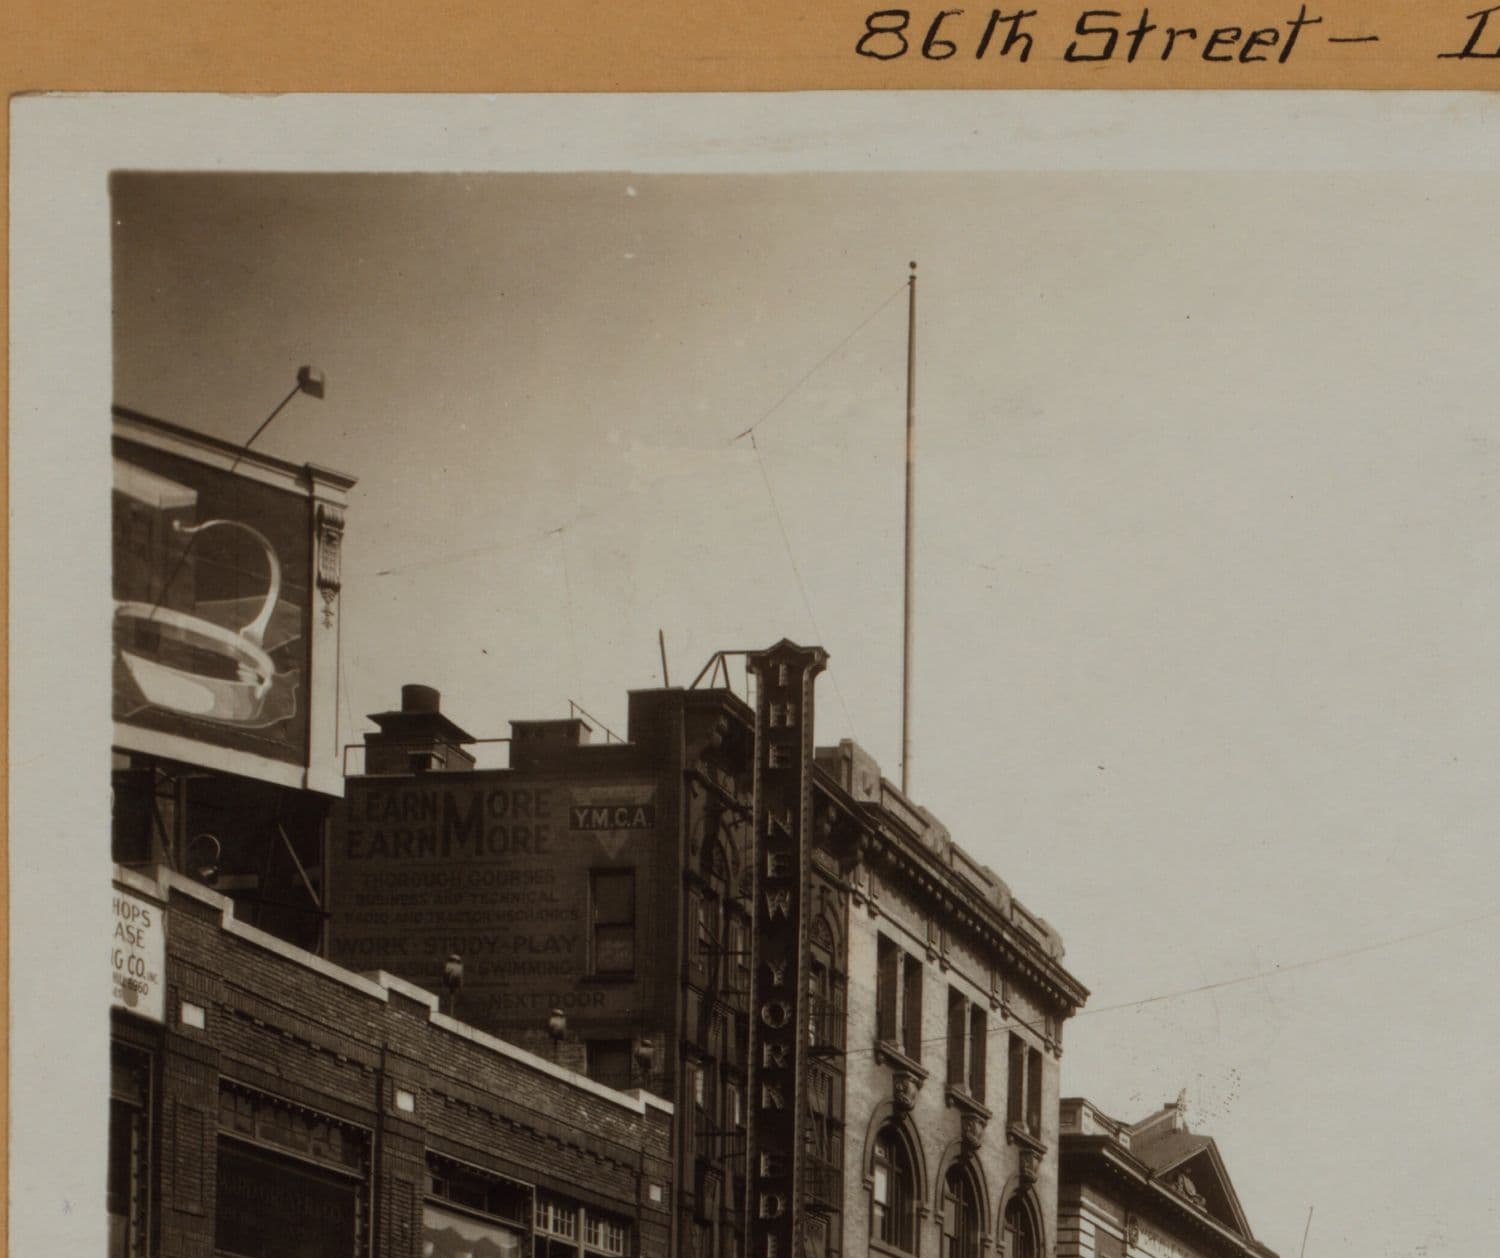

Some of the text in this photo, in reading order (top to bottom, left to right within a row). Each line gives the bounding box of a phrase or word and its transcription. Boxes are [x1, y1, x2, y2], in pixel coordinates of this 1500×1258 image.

[1063, 4, 1323, 64] Street
[767, 662, 797, 769] THE
[346, 827, 438, 859] EARN
[347, 790, 438, 823] LEARN
[765, 807, 793, 921] NEW
[760, 958, 793, 1112] YORK
